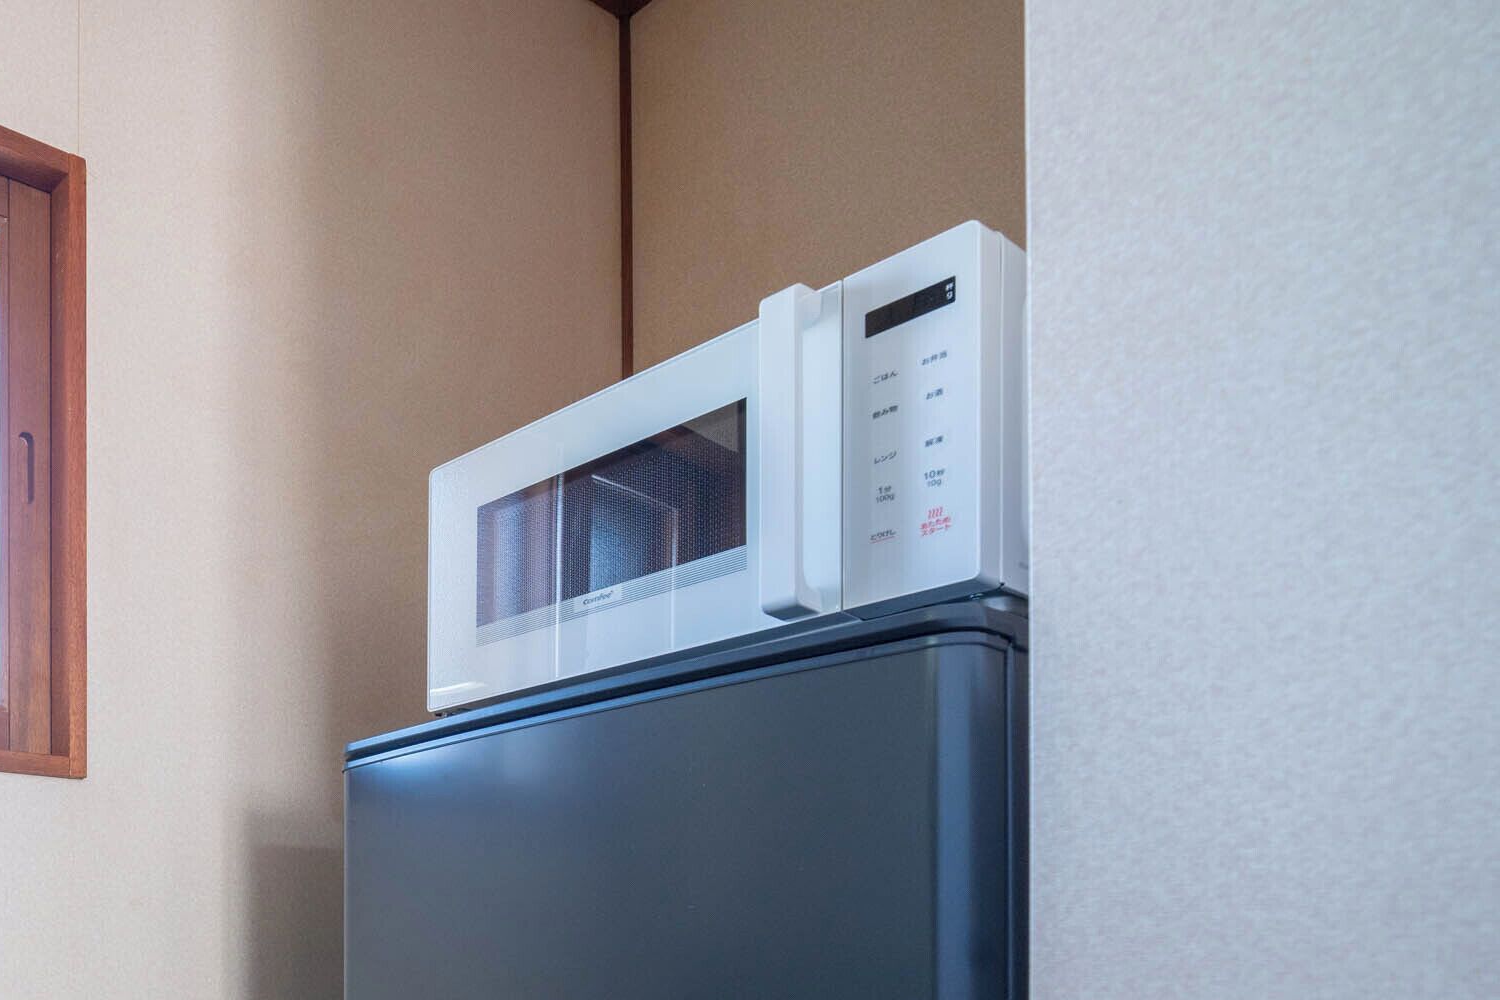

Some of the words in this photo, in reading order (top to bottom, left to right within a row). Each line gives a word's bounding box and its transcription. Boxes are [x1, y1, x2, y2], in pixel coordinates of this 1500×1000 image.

[873, 370, 898, 384] ごはん
[874, 451, 897, 464] レンジ
[927, 479, 942, 488] 10g
[875, 493, 895, 503] 100g
[920, 524, 952, 537] スタート
